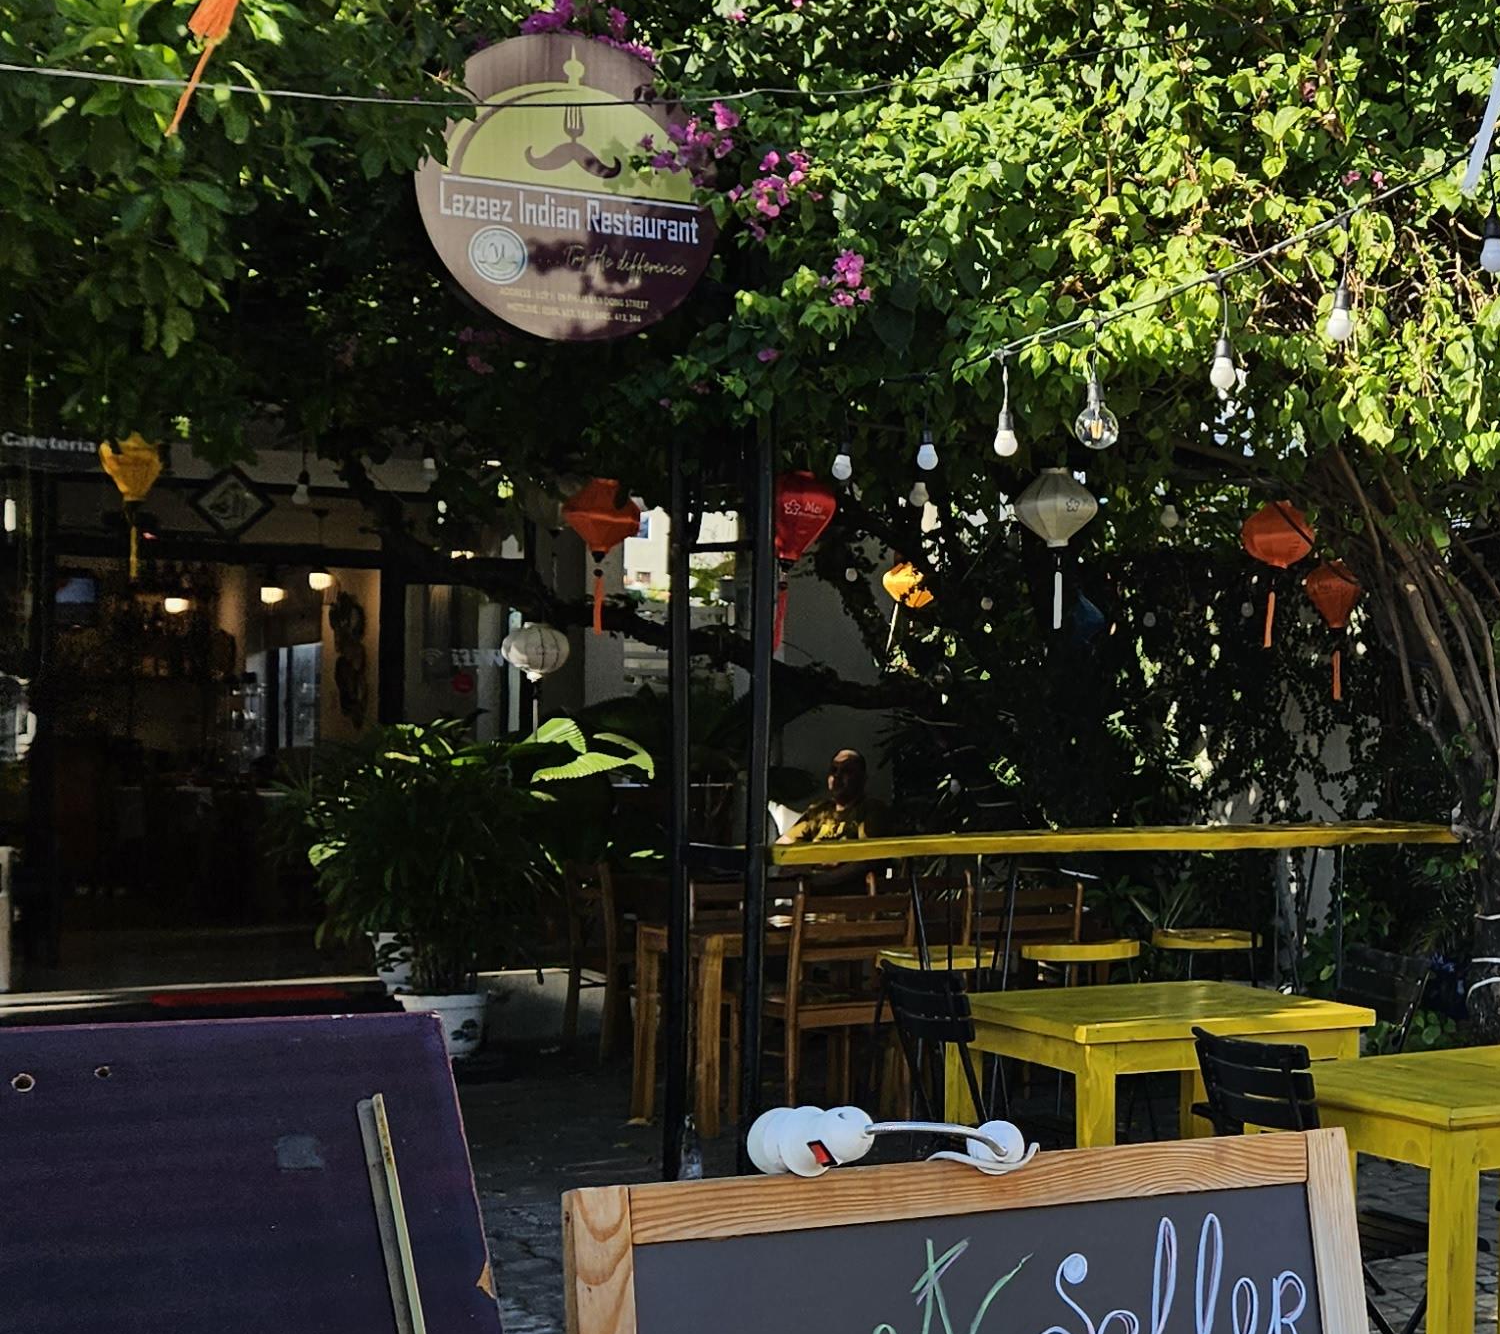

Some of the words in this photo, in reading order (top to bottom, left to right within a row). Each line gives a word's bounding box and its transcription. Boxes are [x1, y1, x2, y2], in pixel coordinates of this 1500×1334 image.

[440, 180, 513, 223] Lazeez
[518, 190, 580, 230] Indian
[586, 199, 699, 244] Restaurant
[1, 431, 97, 454] Cafeteria
